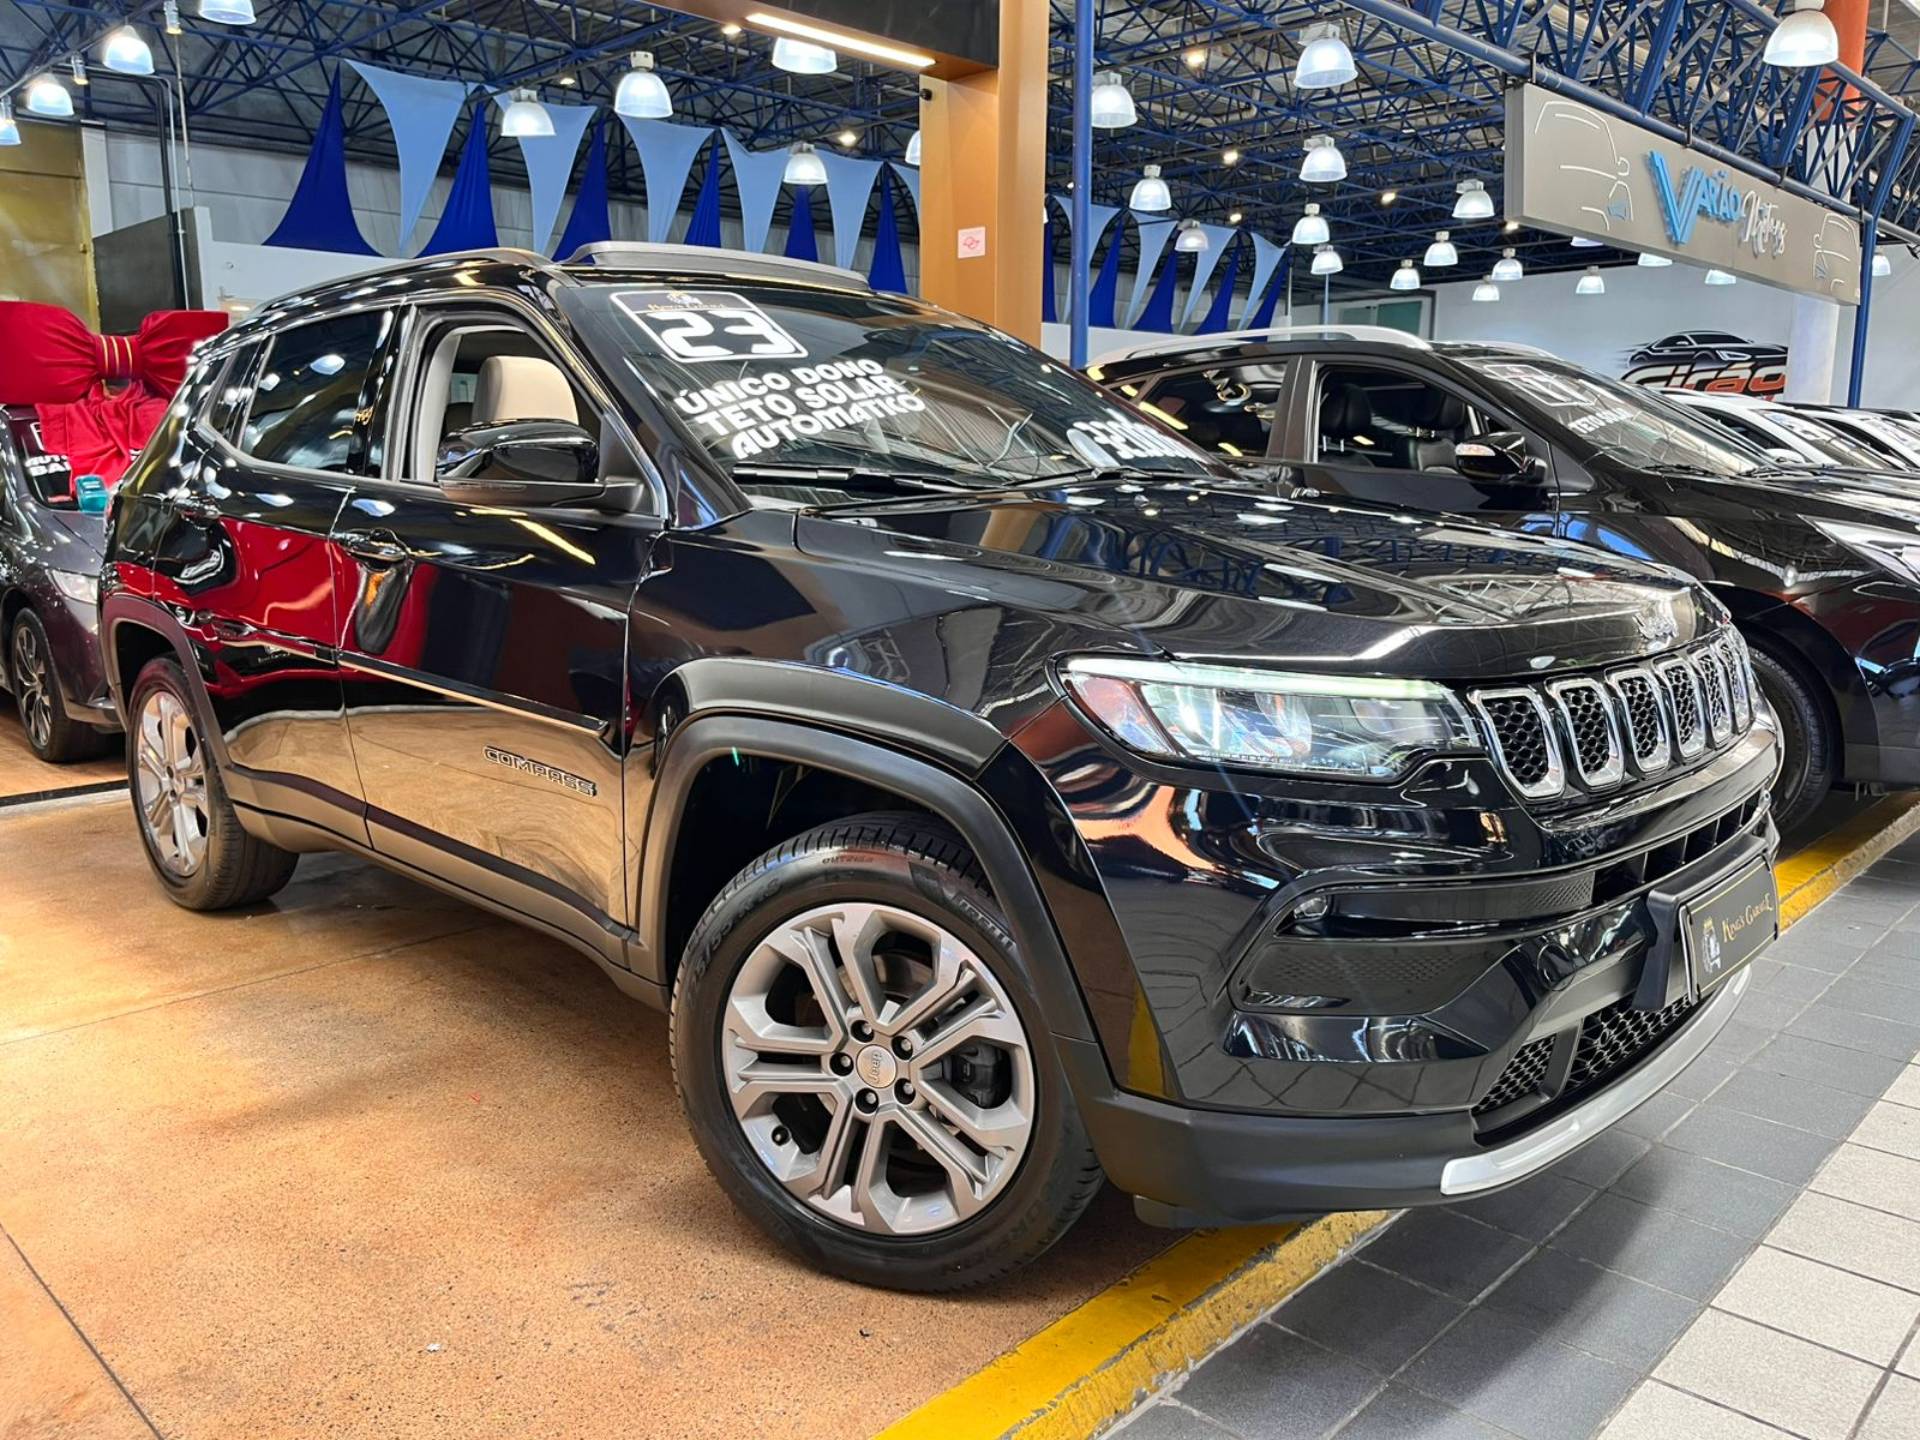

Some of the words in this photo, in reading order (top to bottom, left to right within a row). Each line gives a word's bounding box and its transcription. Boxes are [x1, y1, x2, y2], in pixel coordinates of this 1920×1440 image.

[647, 310, 798, 358] 23
[673, 372, 790, 415] ÚNICO
[790, 359, 884, 387] DONO
[695, 393, 797, 438] TETO
[795, 374, 904, 410] SOLAR
[483, 746, 598, 797] COMPASS
[869, 1049, 883, 1084] Jeep
